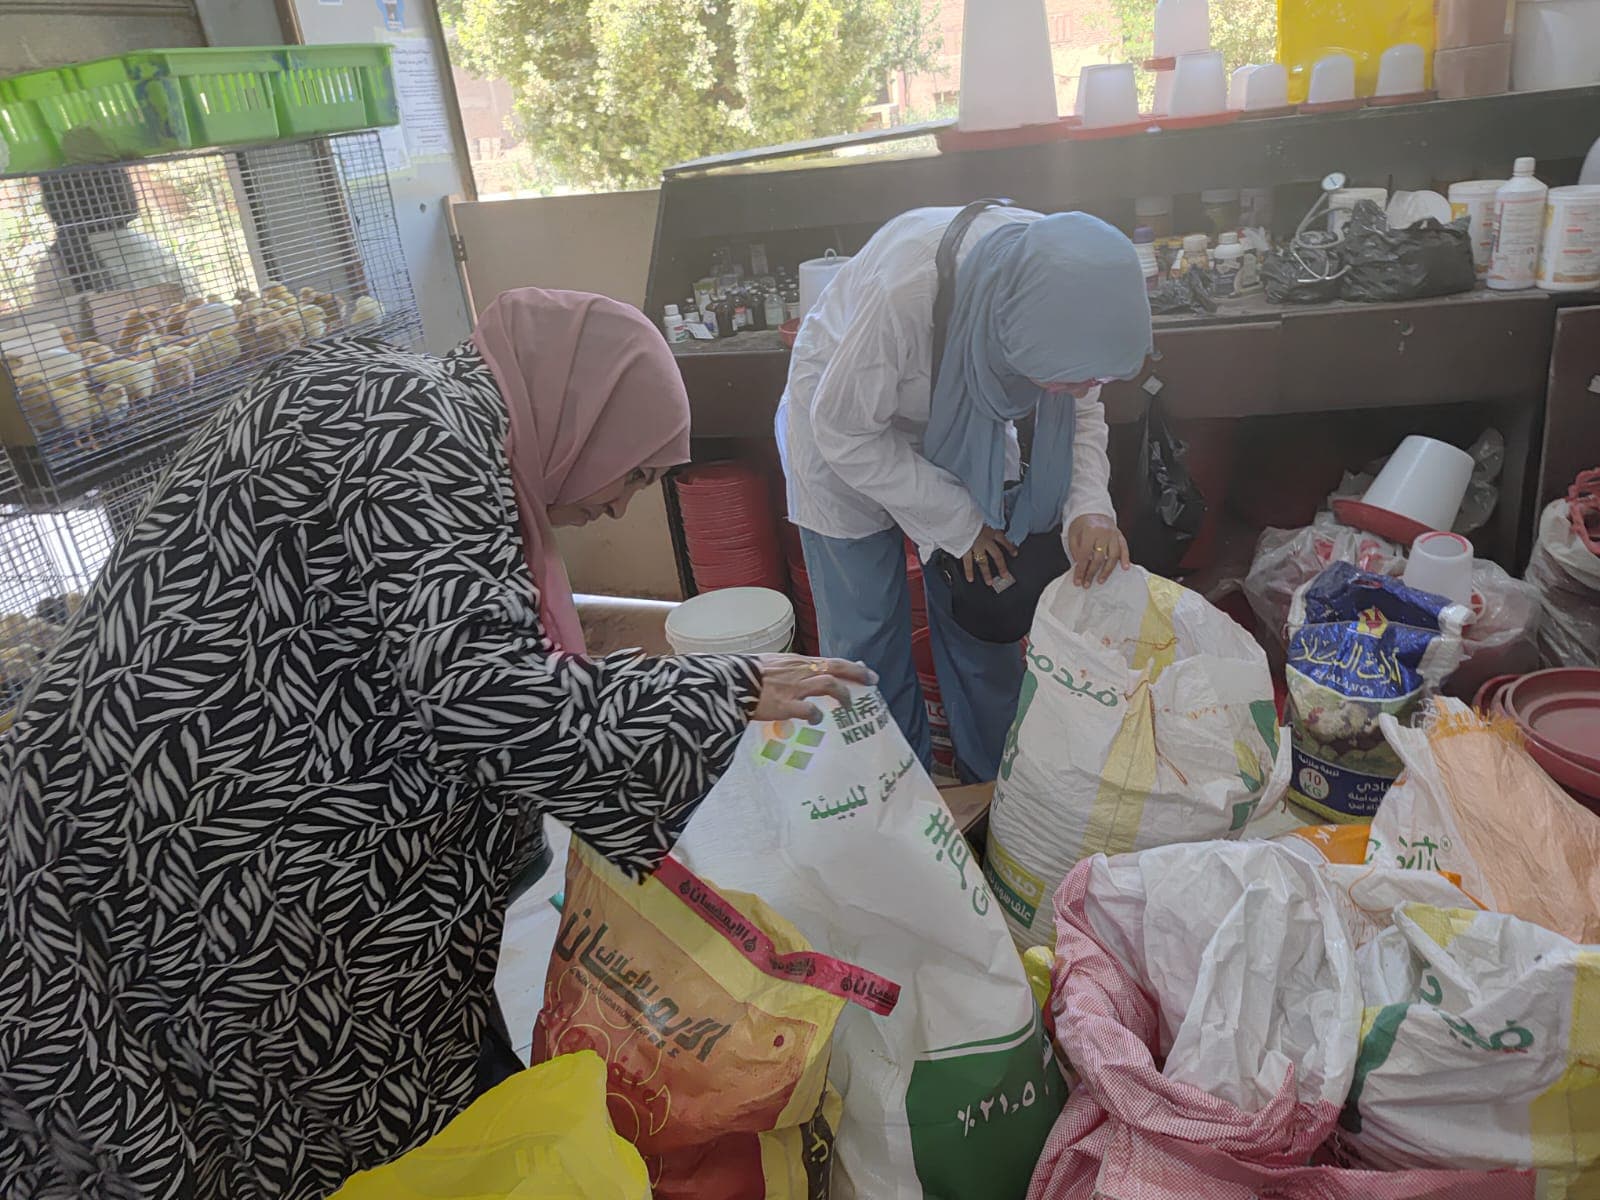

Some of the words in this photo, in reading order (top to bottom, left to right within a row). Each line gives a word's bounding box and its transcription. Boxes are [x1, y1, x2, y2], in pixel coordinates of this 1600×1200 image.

[841, 721, 876, 745] NEW
[1306, 771, 1322, 786] 10
[1303, 782, 1323, 797] KG
[801, 784, 868, 820] للبيئة
